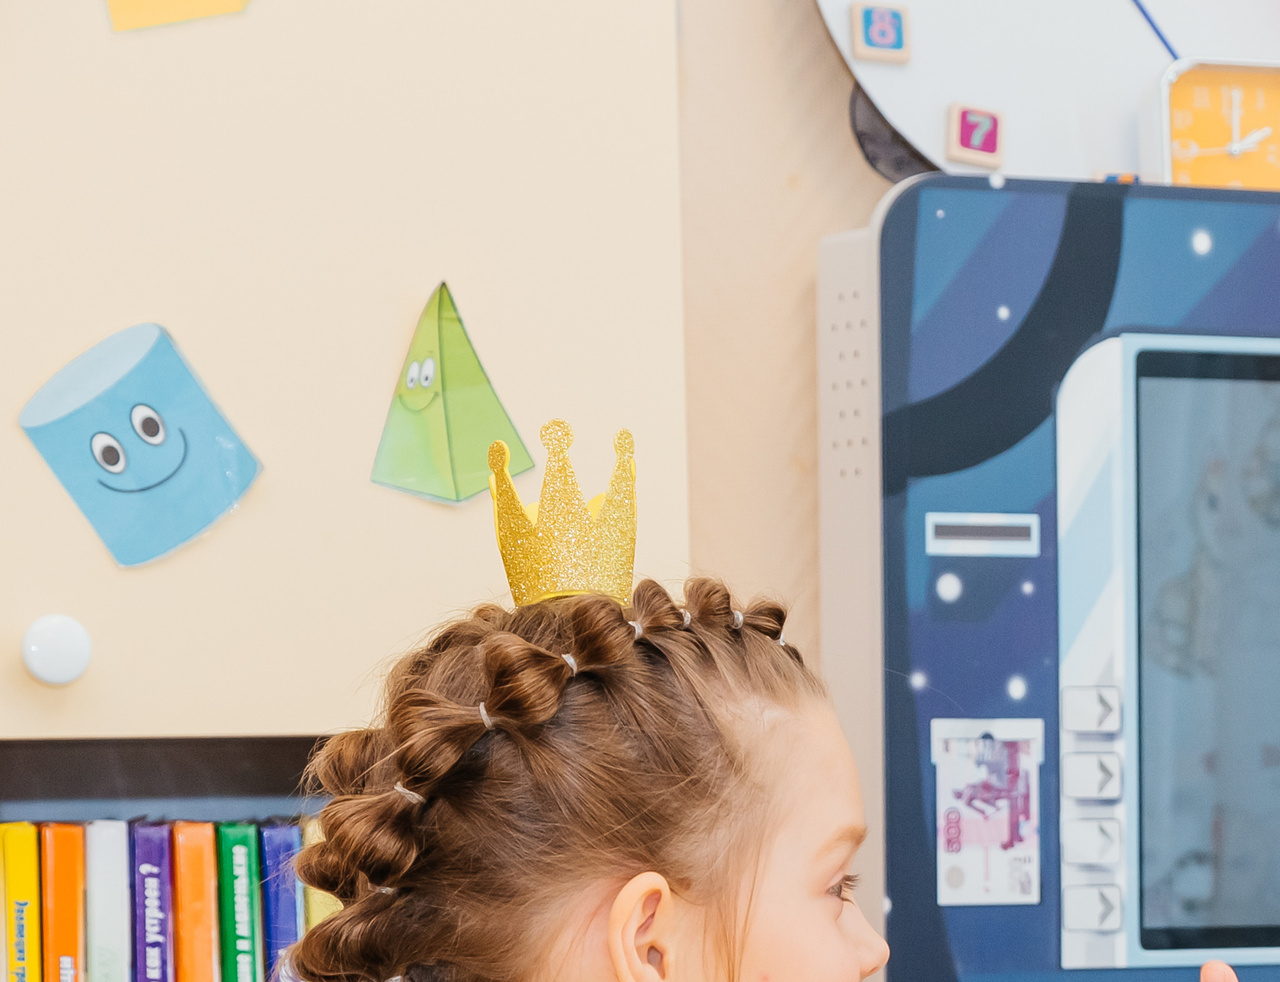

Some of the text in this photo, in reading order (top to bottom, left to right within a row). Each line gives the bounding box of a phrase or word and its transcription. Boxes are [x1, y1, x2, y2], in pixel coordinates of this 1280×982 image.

[868, 8, 896, 47] 8
[966, 111, 993, 149] 7
[145, 947, 162, 979] как
